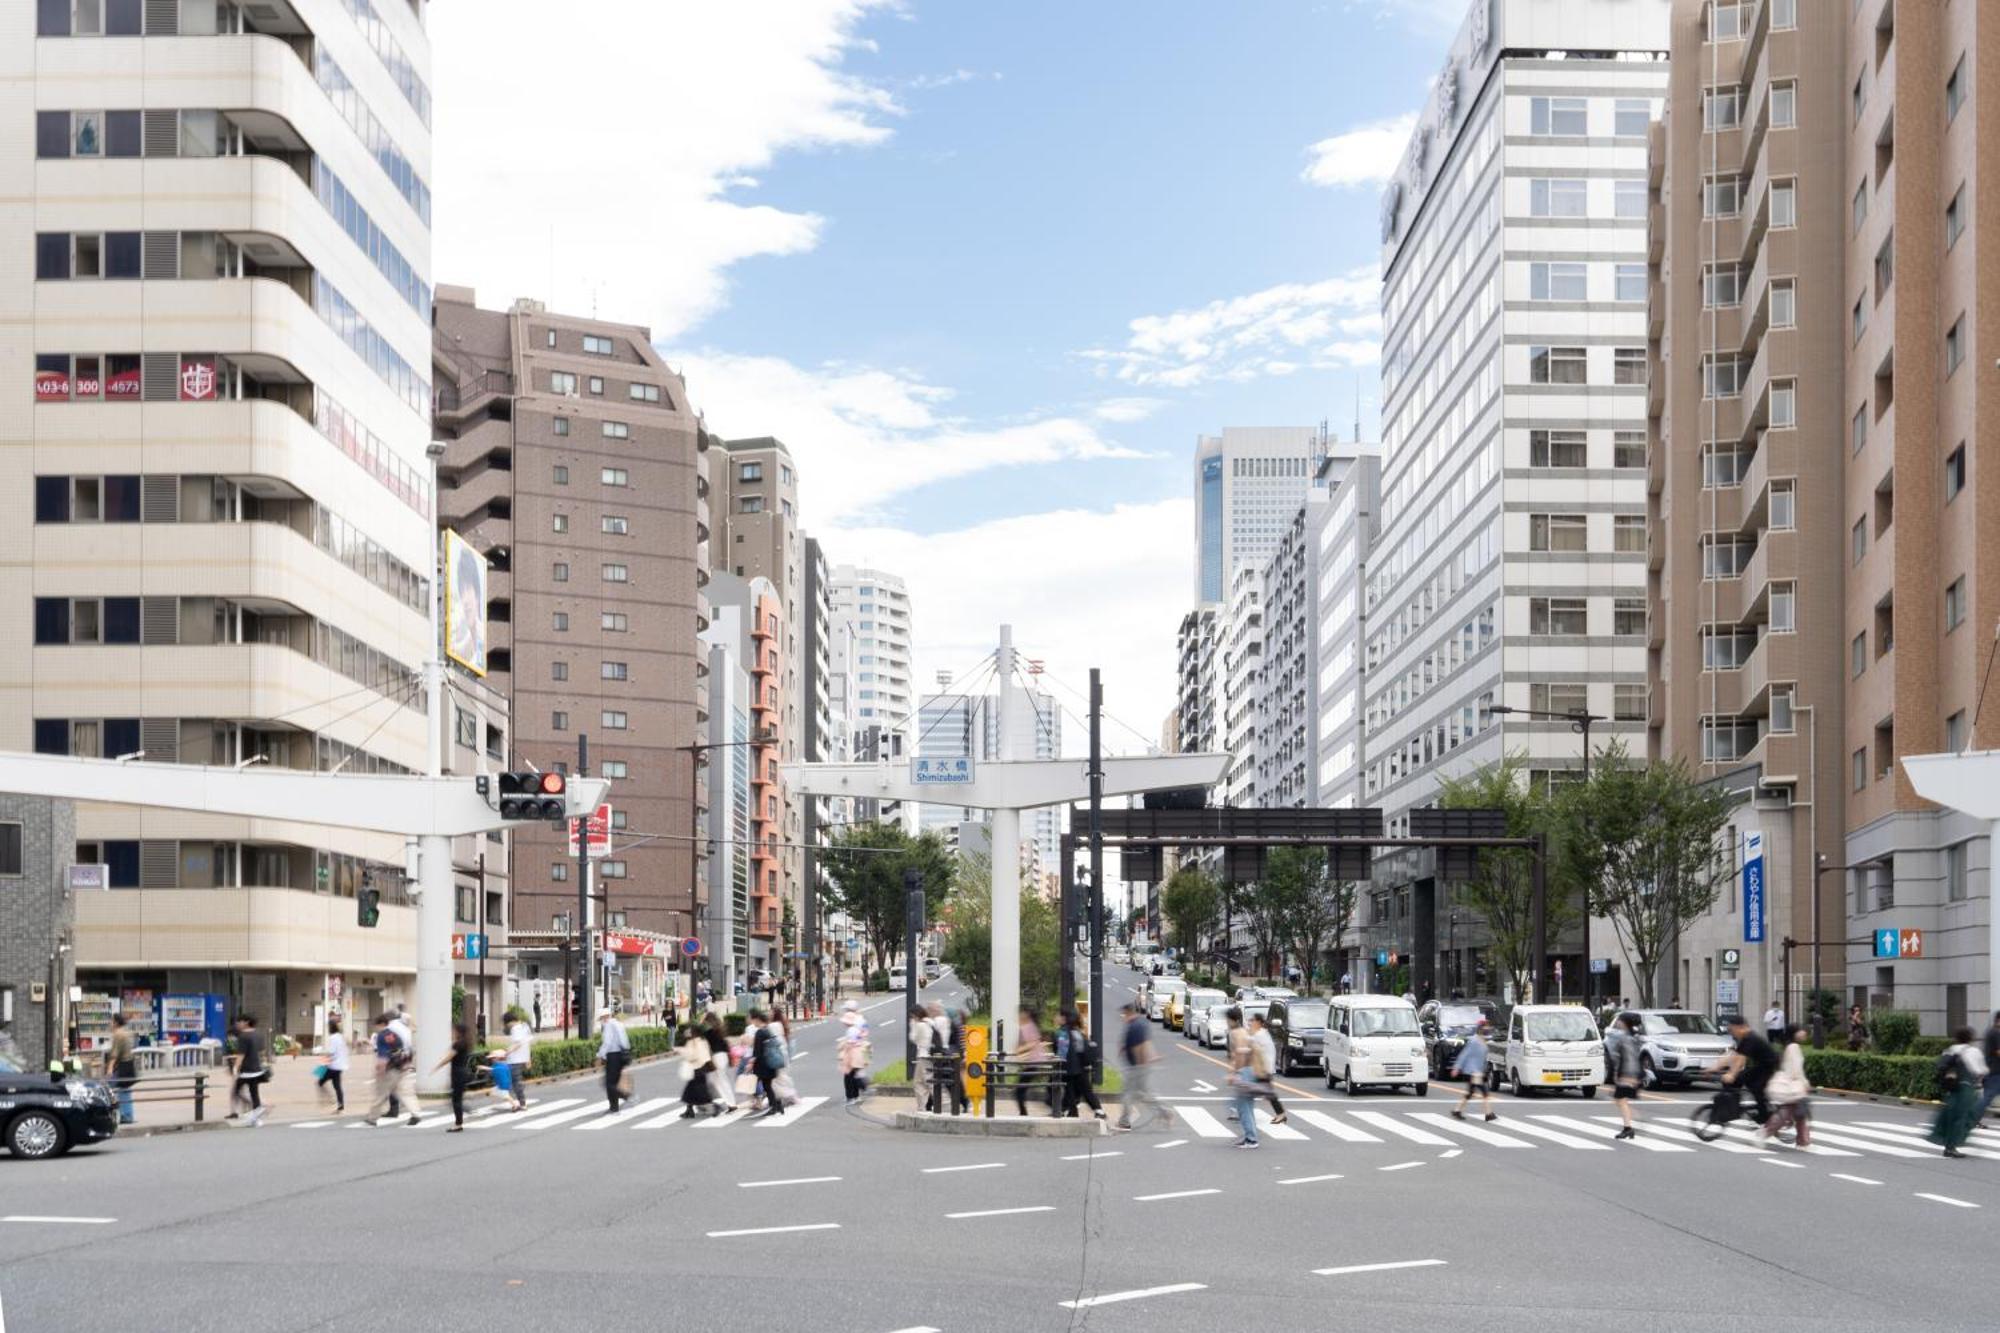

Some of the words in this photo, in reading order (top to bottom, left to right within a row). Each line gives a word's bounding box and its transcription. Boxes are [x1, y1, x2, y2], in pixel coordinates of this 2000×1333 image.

[916, 760, 967, 772] 清水橋
[917, 772, 968, 782] Shimizubashi
[1749, 866, 1760, 938] さわやか信用金庫
